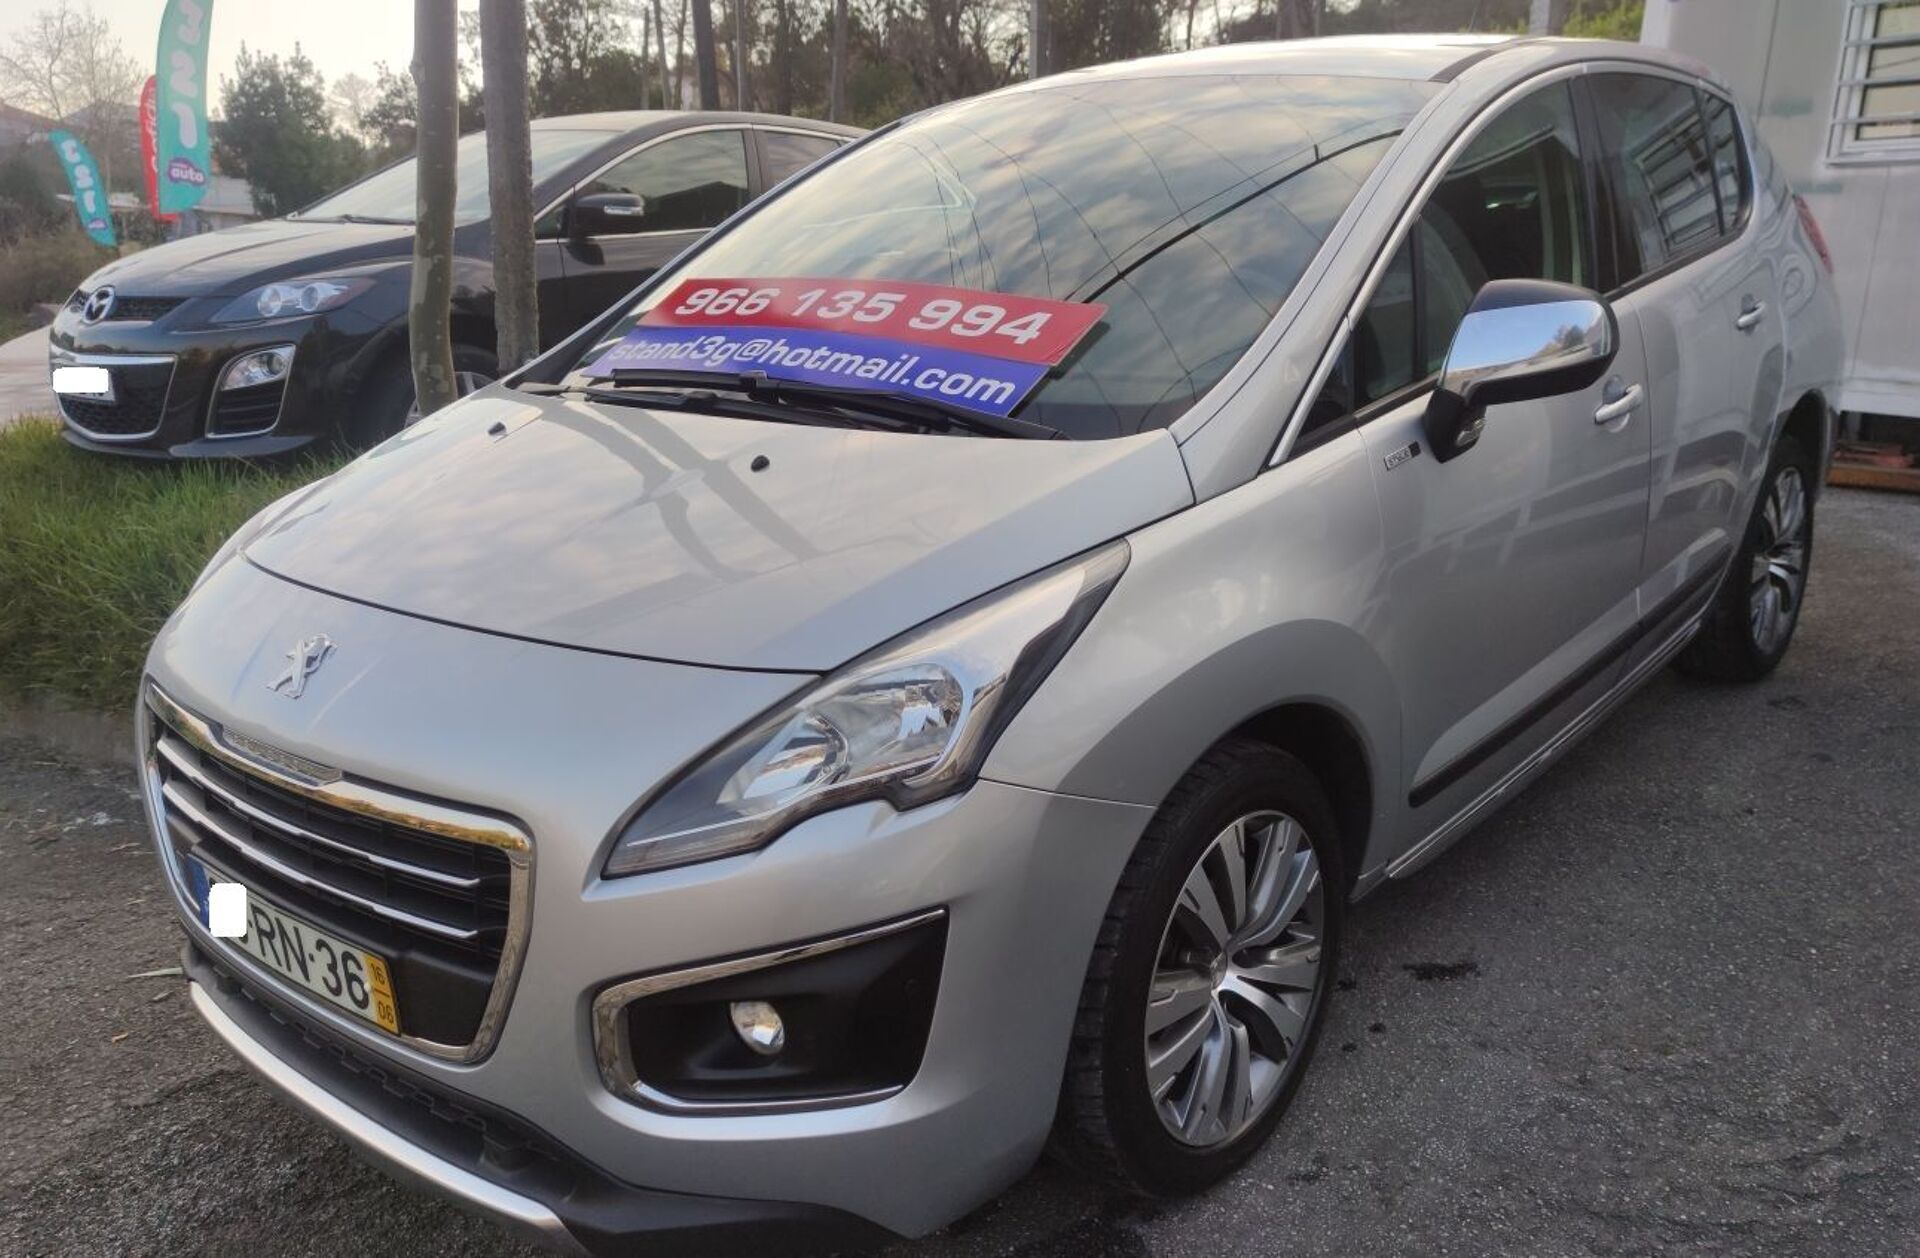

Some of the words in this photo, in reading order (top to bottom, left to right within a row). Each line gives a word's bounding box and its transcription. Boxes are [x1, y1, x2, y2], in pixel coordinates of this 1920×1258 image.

[170, 165, 204, 182] auto
[675, 287, 780, 316] 966
[791, 288, 907, 323] 135
[908, 298, 1053, 345] 994
[608, 335, 1016, 405] stand3g@hotmail.com
[370, 962, 387, 986] 16
[378, 1000, 395, 1025] 06
